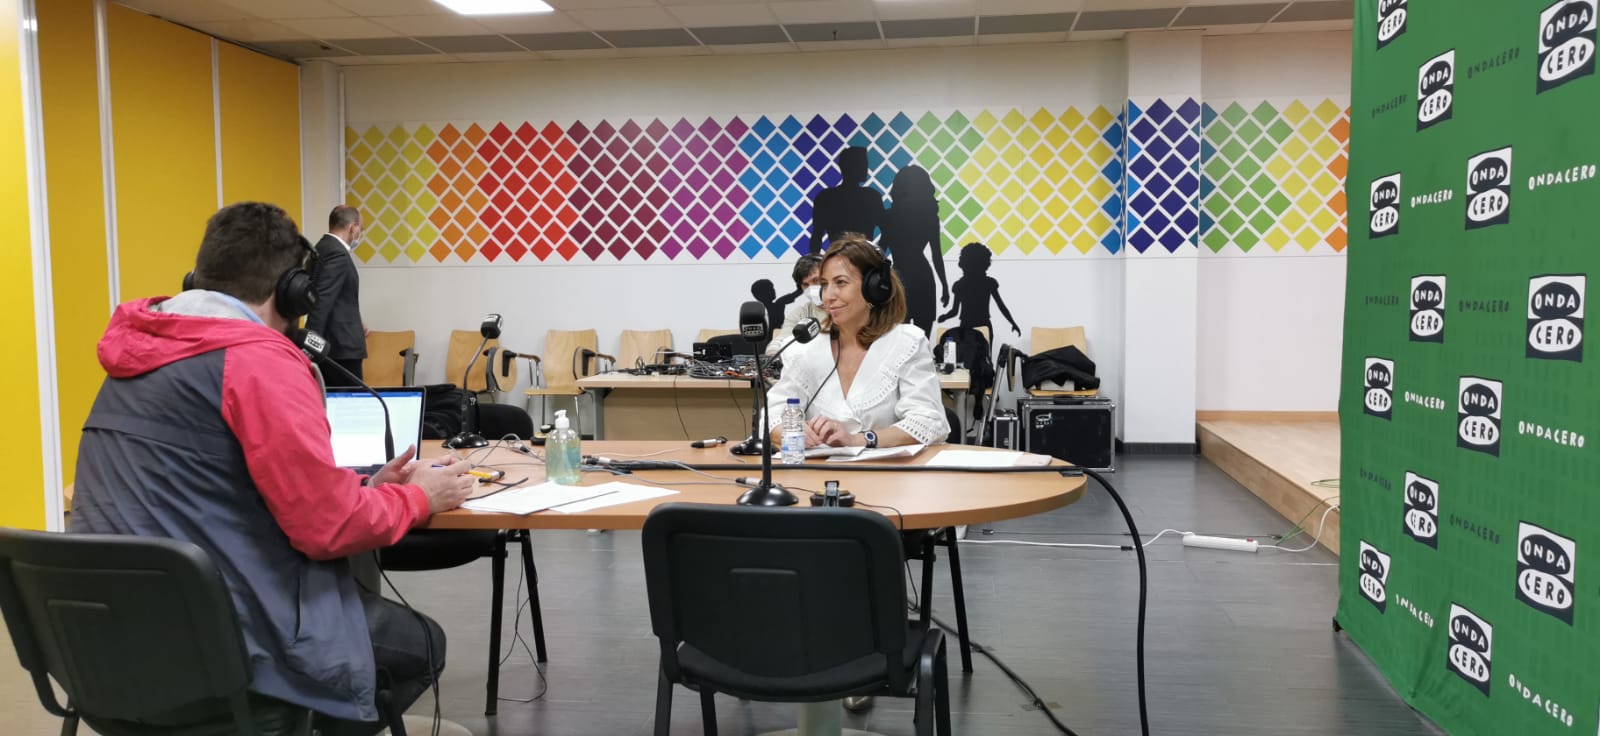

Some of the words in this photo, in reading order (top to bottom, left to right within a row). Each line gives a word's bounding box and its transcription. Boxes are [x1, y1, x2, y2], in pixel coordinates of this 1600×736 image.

[1382, 13, 1402, 36] CERO
[1546, 8, 1589, 40] ONDA
[1467, 47, 1520, 79] ONDACERO
[1547, 44, 1586, 74] CERO
[1422, 67, 1448, 90] ONDA
[1423, 94, 1448, 117] CERO
[1472, 165, 1505, 186] ONDA
[1528, 164, 1597, 191] ONDACERO
[1374, 188, 1396, 203] ONDA
[1411, 189, 1452, 208] ONDACERO
[1473, 194, 1503, 215] CERO
[1375, 212, 1395, 227] CERO
[1415, 290, 1440, 302] ONDA
[1459, 300, 1509, 312] ONDACERO
[1535, 293, 1576, 310] ONDA
[1416, 315, 1439, 330] CERO
[1536, 325, 1574, 345] CERO
[1368, 369, 1389, 383] ONDA
[1369, 392, 1388, 408] CERO
[1464, 391, 1496, 409] ONDA
[1465, 420, 1493, 440] CERO
[1518, 421, 1585, 448] ONDACERO
[1450, 513, 1500, 545] ONDACERO
[1362, 552, 1382, 574] ONDA
[1523, 539, 1566, 570] ONDA
[1364, 575, 1382, 598] CERO
[1524, 578, 1565, 604] CERO
[1396, 593, 1433, 628] NACEO
[1454, 619, 1485, 648] ONDA
[1454, 647, 1484, 678] CERO
[1509, 673, 1573, 727] ONDACERO
